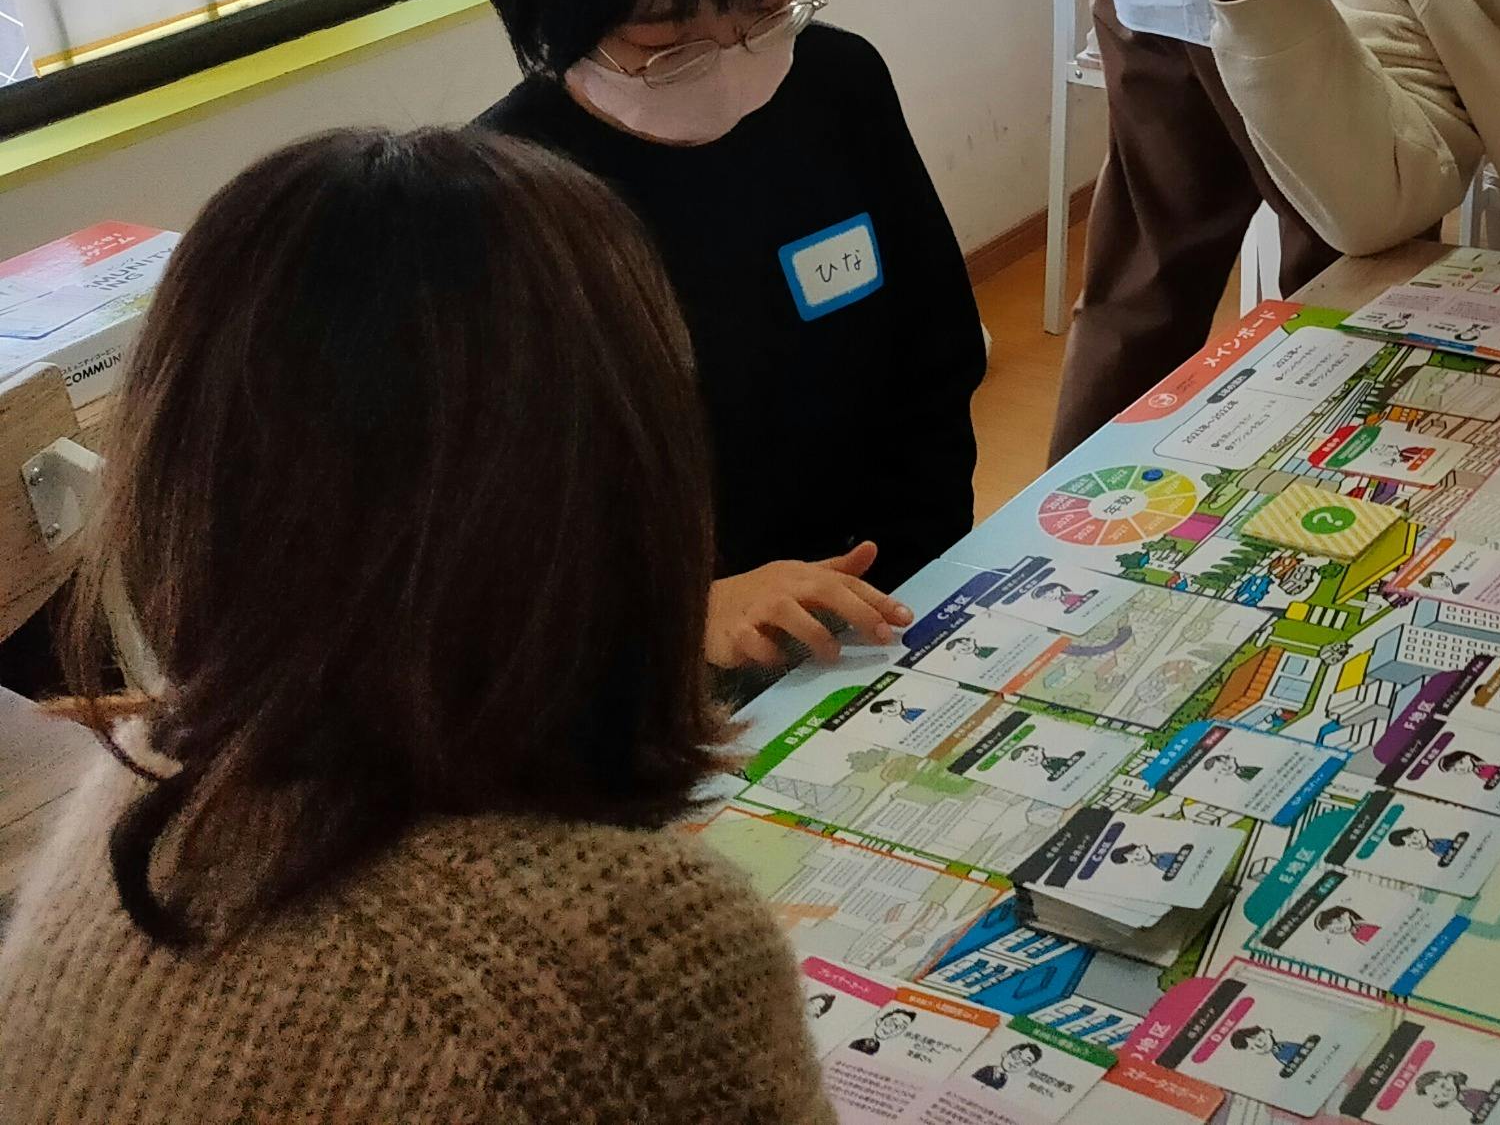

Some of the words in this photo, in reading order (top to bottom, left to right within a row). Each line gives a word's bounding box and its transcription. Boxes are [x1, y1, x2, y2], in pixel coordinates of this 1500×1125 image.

[815, 249, 863, 283] ひな
[1203, 309, 1277, 368] メインボード
[936, 593, 974, 621] C地区
[1402, 699, 1437, 732] F地区
